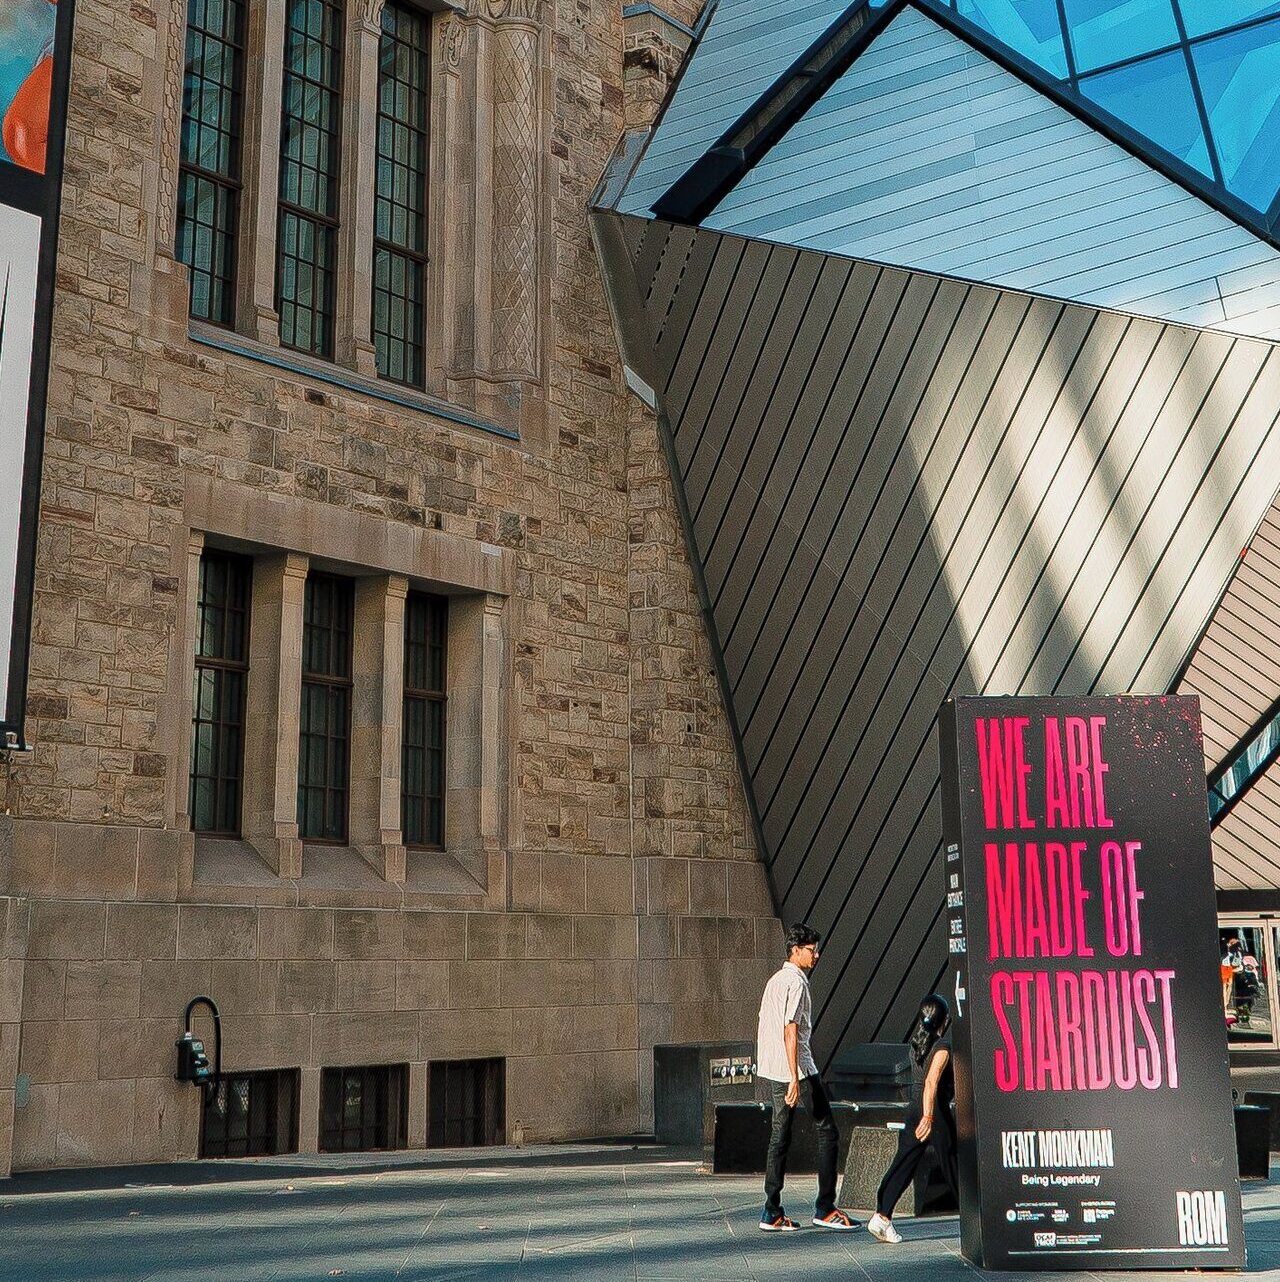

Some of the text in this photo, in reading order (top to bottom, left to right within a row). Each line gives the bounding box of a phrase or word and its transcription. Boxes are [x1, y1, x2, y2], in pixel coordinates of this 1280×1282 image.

[976, 716, 1114, 830] WE ARE
[984, 841, 1145, 960] MADE OF
[990, 970, 1179, 1093] STARDUST
[1001, 1129, 1114, 1169] KENT MONKMAN
[1021, 1174, 1101, 1188] Being Legendary
[1176, 1191, 1229, 1246] ROM
